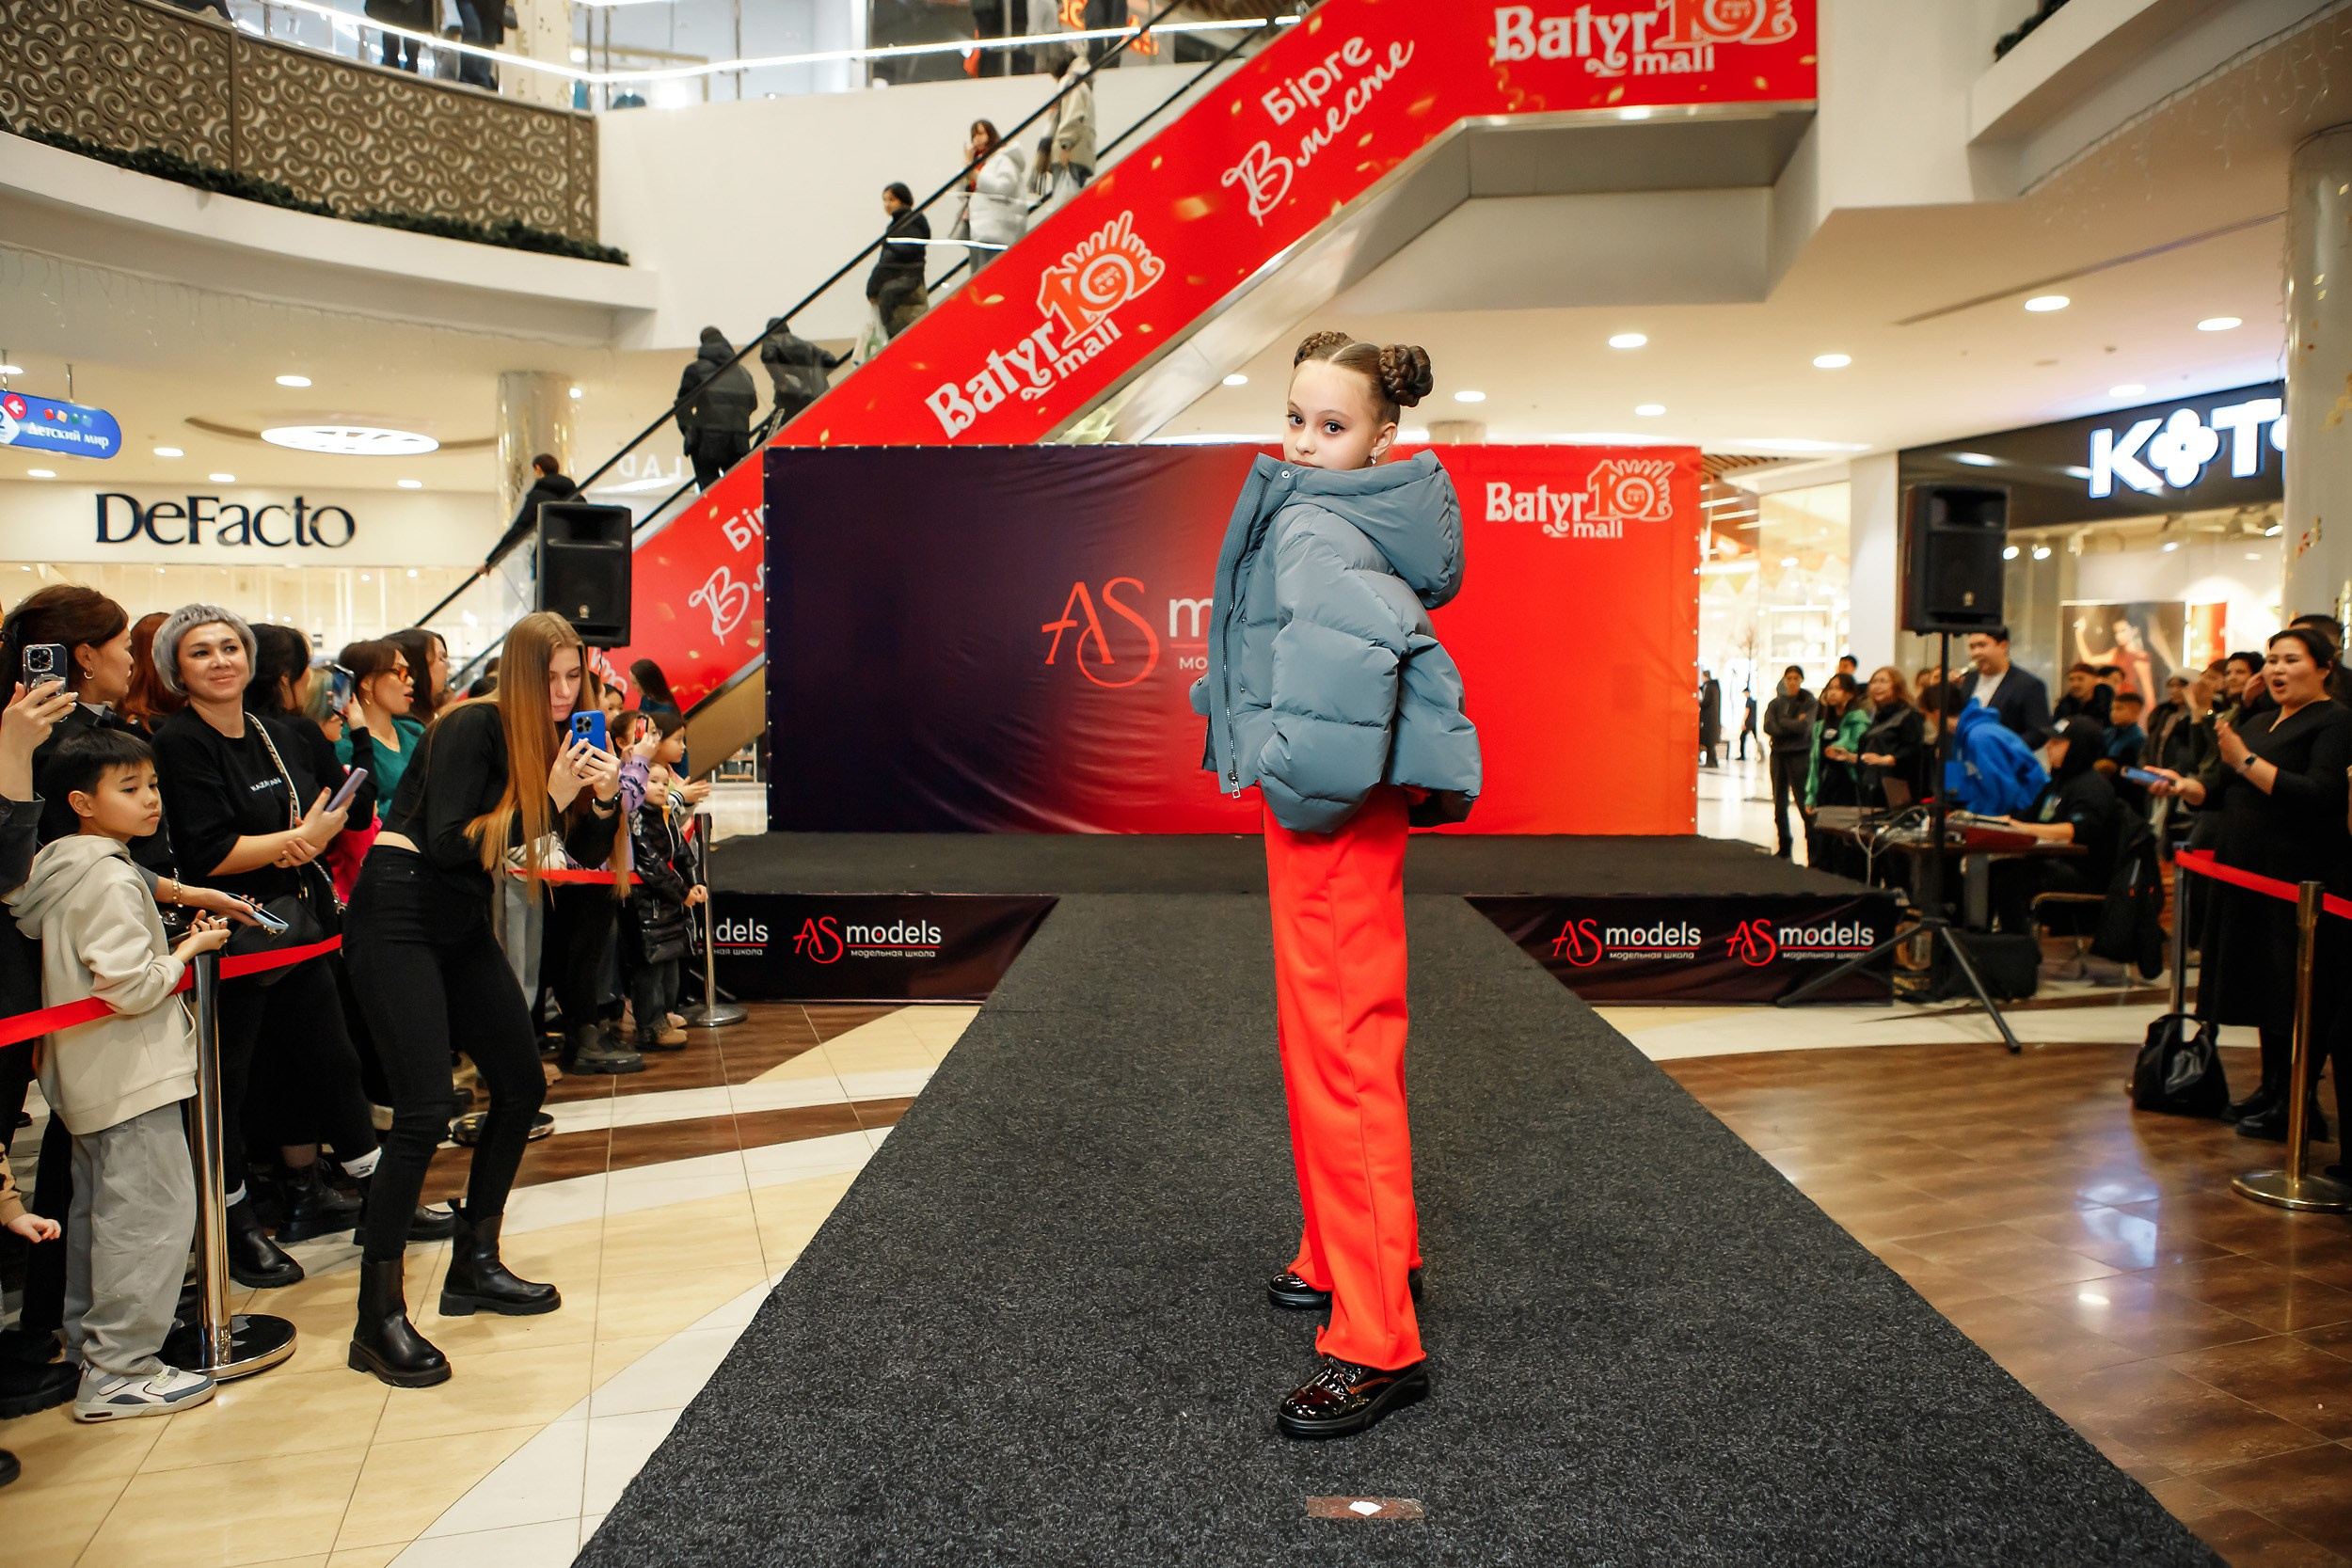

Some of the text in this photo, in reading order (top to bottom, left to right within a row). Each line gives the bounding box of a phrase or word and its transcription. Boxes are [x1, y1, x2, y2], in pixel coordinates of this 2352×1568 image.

[1494, 4, 1659, 77] Batyr
[1632, 45, 1715, 76] mall
[1261, 37, 1373, 125] Бірге
[1221, 40, 1414, 227] Вместе
[1053, 318, 1122, 379] mall
[925, 320, 1061, 439] Batyr
[26, 421, 81, 442] Детский
[84, 434, 109, 450] мир
[2089, 398, 2287, 499] KOT
[95, 493, 356, 548] DeFacto
[1486, 482, 1589, 538] Batyr
[1573, 520, 1623, 538] mall
[1041, 577, 1160, 689] AS
[793, 916, 942, 964] AS models
[850, 950, 903, 958] модельная
[1552, 918, 1702, 967] AS models
[1610, 952, 1662, 960] модельная
[1725, 918, 1875, 967] AS models
